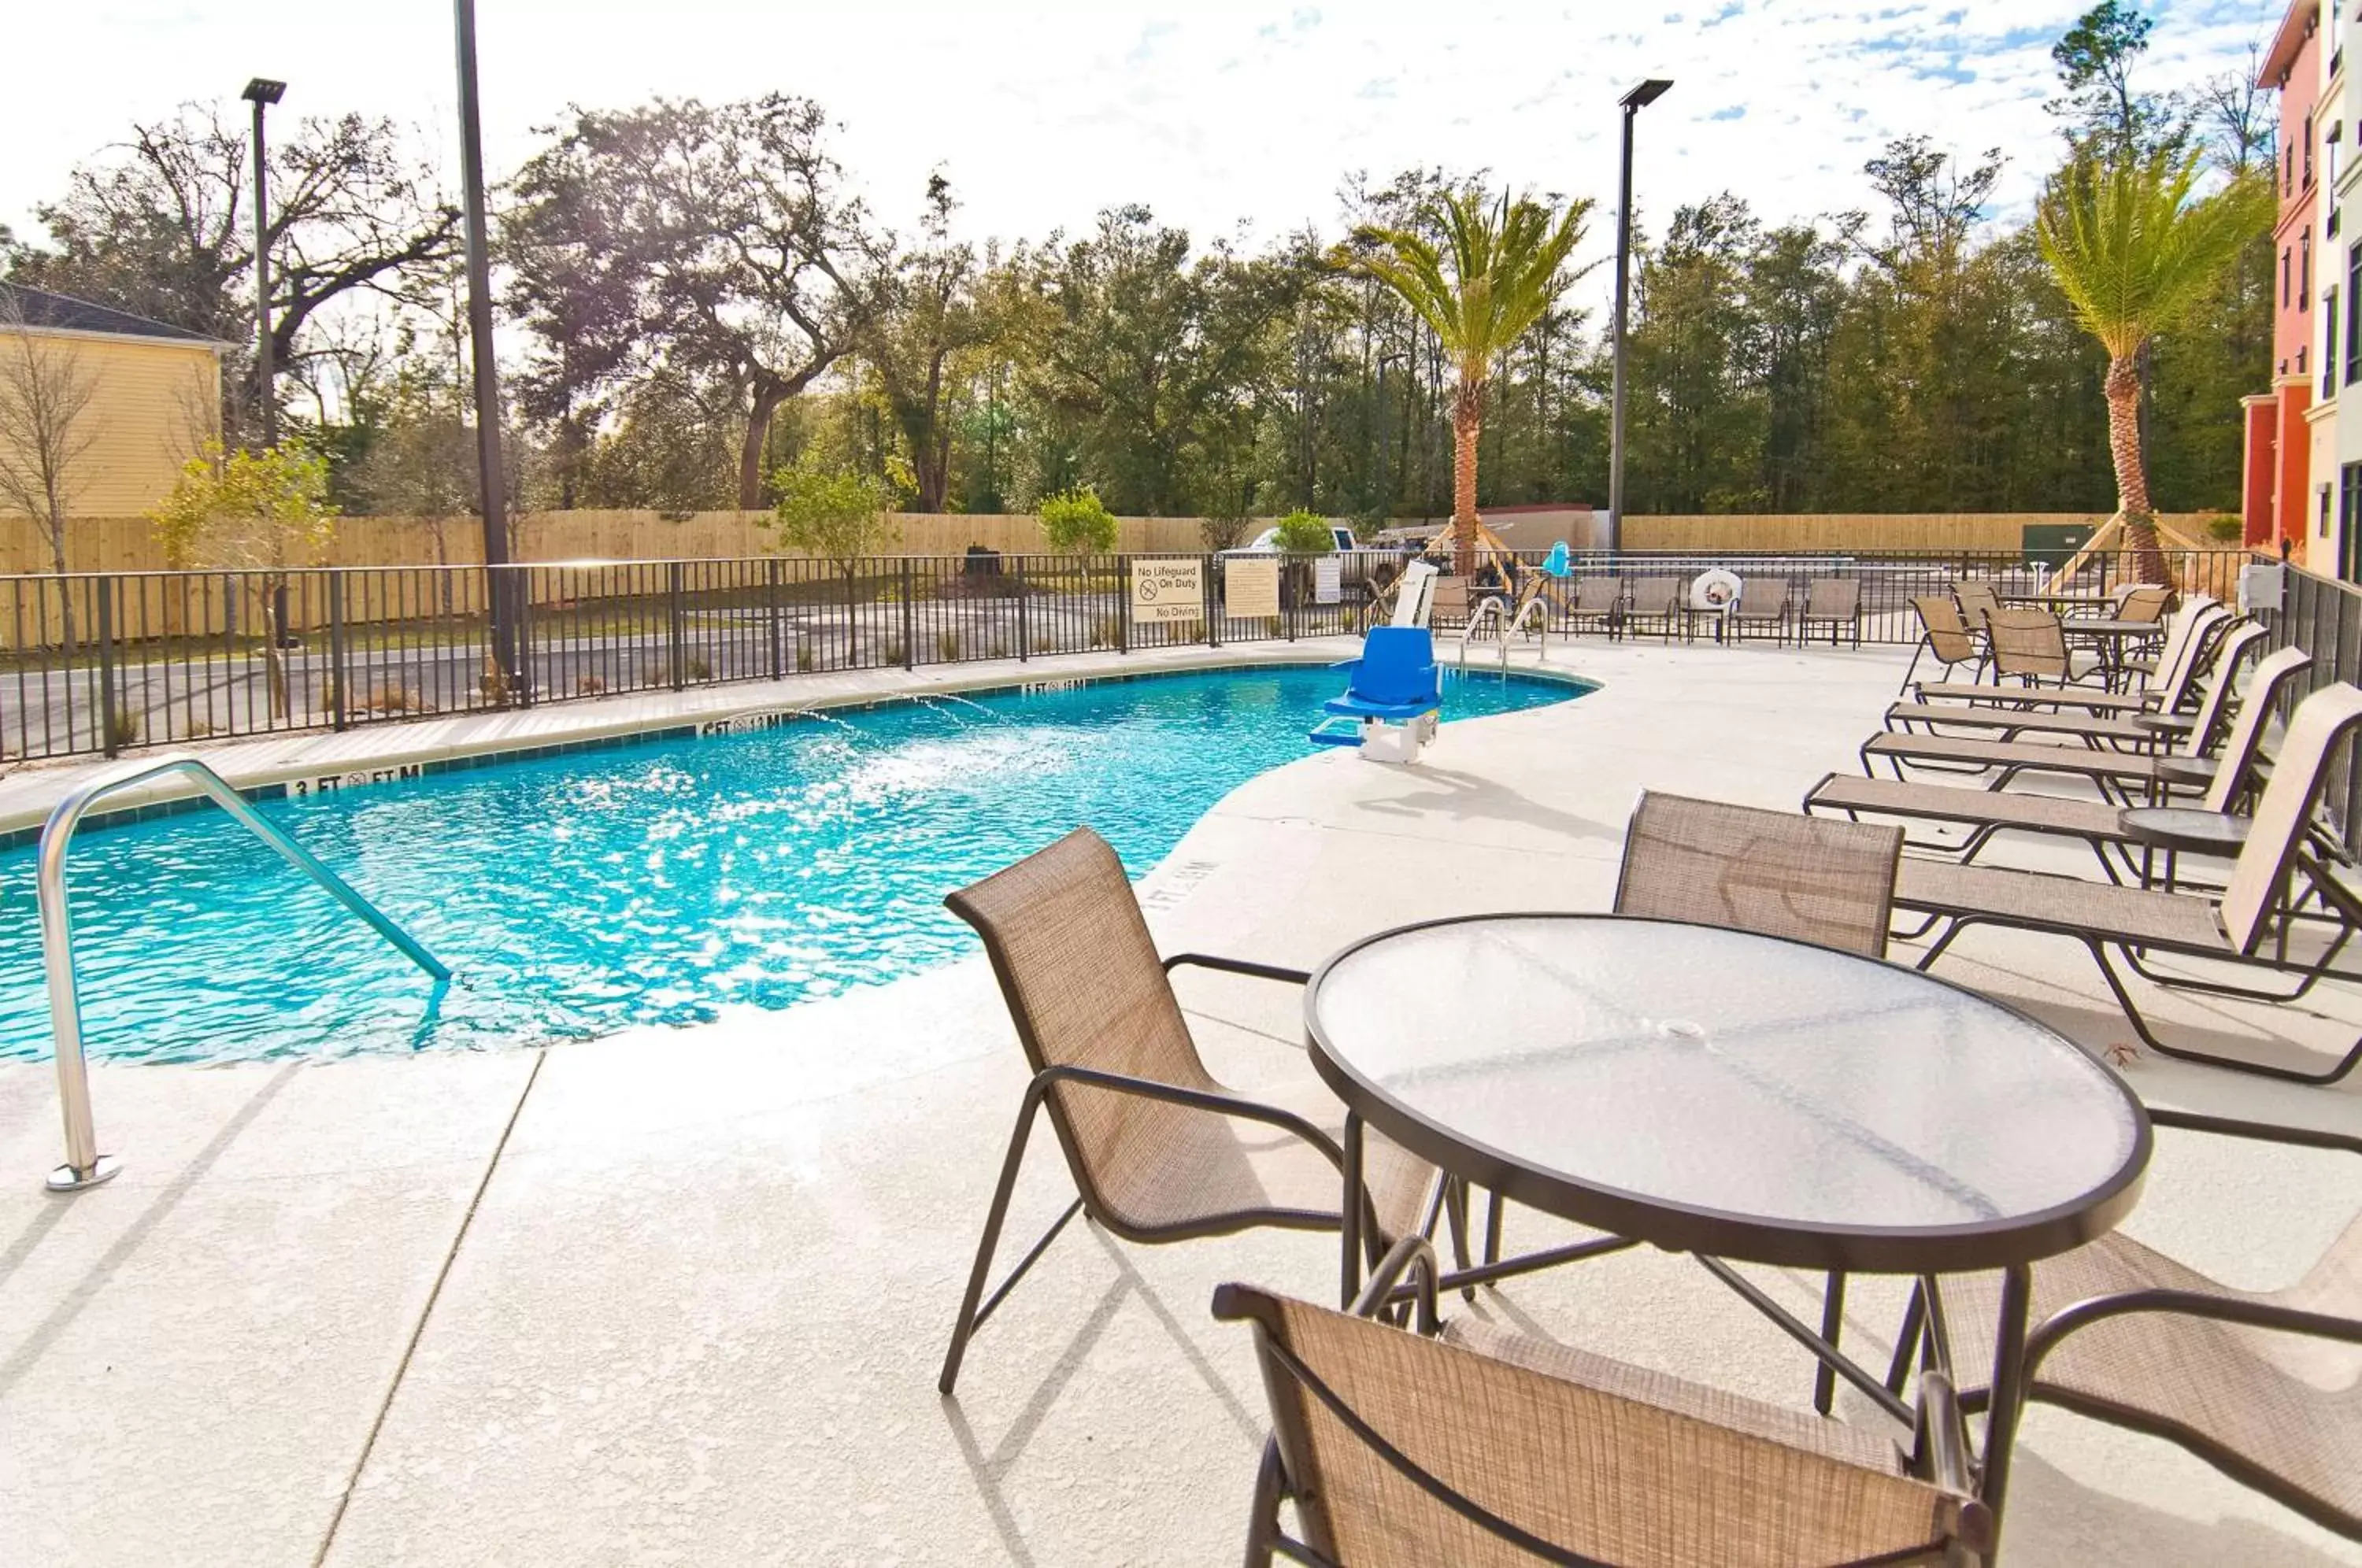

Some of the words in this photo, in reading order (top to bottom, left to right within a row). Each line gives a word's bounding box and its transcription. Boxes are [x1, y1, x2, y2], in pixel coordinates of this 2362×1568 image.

[1138, 567, 1152, 577] No
[1153, 566, 1196, 579] Lifeguard
[1160, 579, 1172, 588] On
[1175, 579, 1198, 590] Duty
[1157, 608, 1169, 618] No
[1172, 605, 1200, 618] Diving
[715, 720, 731, 736] FT
[317, 775, 342, 793] FT
[400, 764, 420, 780] M
